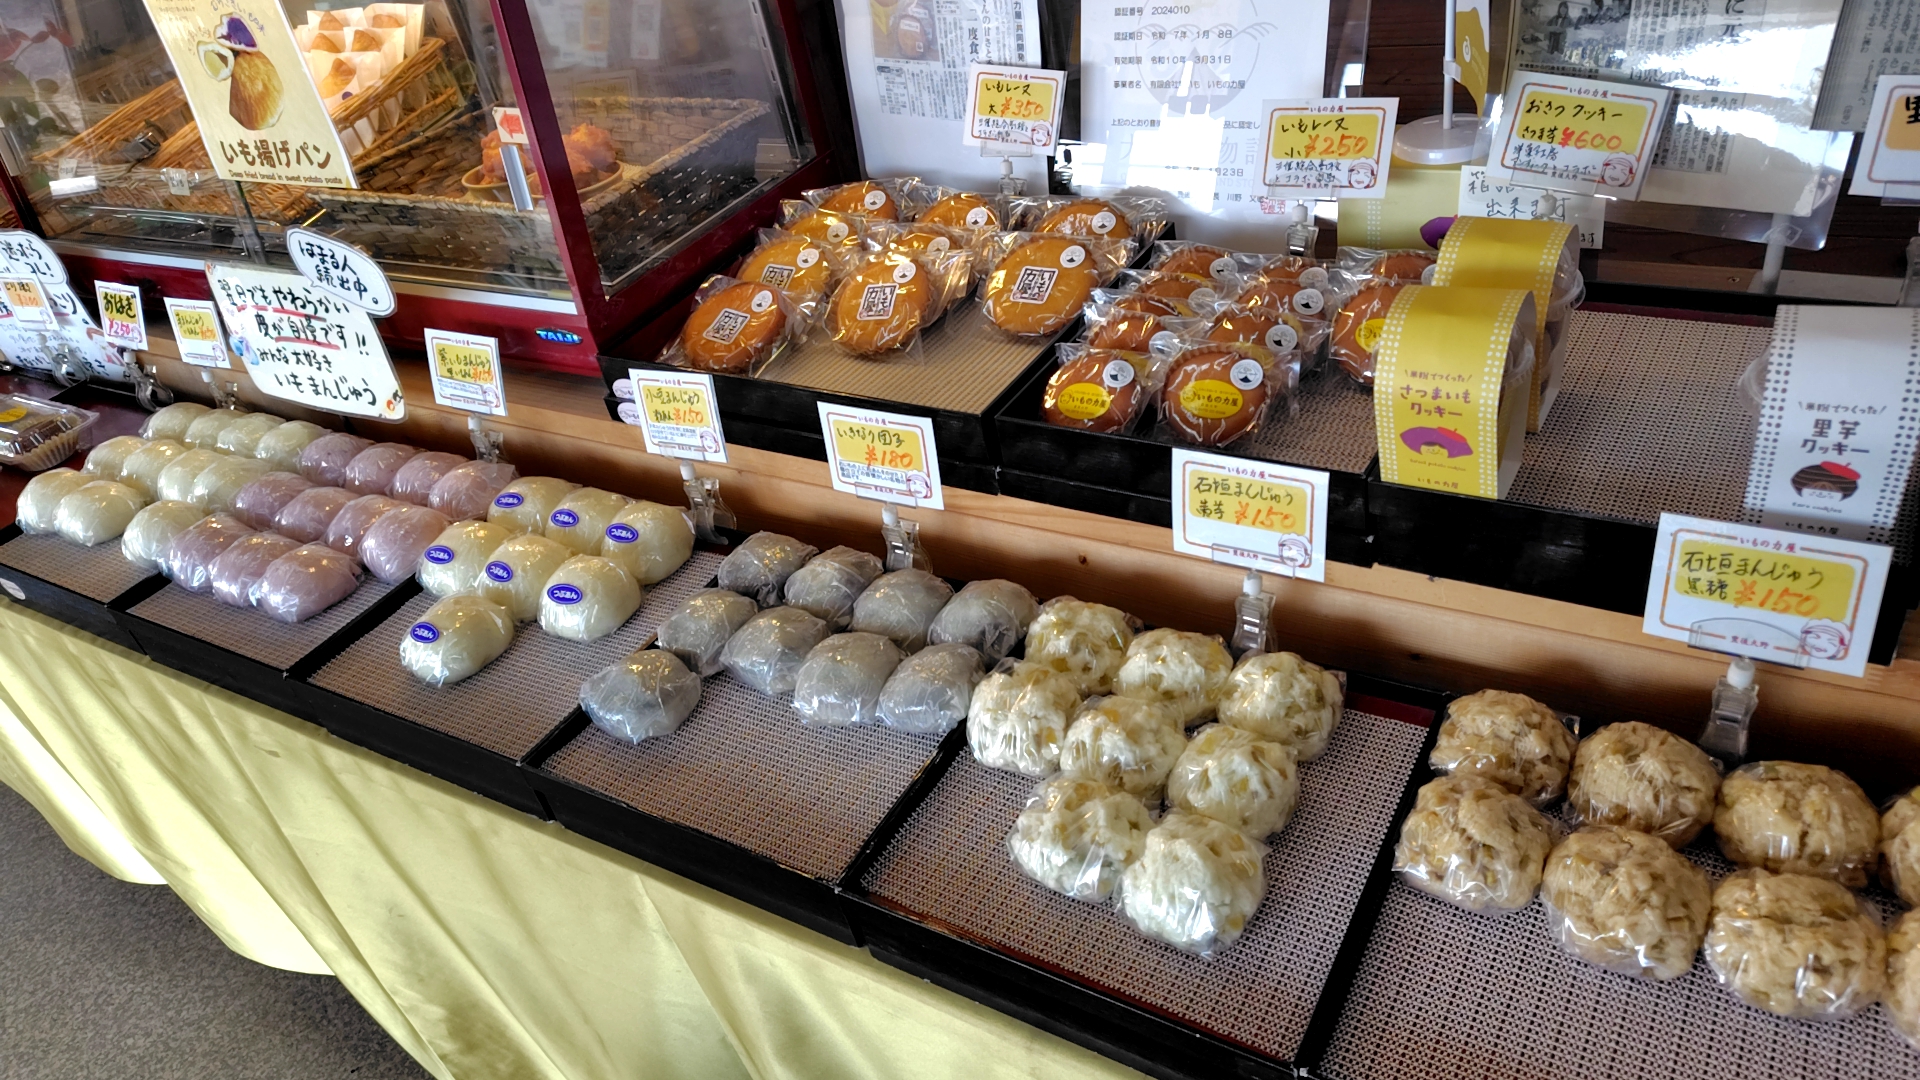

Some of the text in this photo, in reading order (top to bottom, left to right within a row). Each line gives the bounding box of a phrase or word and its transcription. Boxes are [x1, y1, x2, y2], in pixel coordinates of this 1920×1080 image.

[1114, 6, 1190, 17] 認証番号 2024010
[1114, 32, 1143, 41] 認証期日
[1114, 56, 1142, 65] 有効期限
[1194, 55, 1231, 65] 3月31日
[1114, 81, 1142, 89] 事業者名
[1208, 80, 1246, 90] いもの力屋
[1569, 86, 1609, 99] いもの力屋
[989, 97, 1044, 117] 大 ¥350
[1284, 133, 1368, 158] 小 ¥250
[1558, 126, 1622, 150] ¥600
[220, 138, 336, 169] いも揚げパン
[297, 239, 357, 276] はまる人
[103, 291, 137, 319] おはぎ
[108, 318, 131, 336] ¥250
[1197, 393, 1239, 407] いもの力屋
[1400, 384, 1471, 404] さつまいも
[673, 407, 704, 426] ¥150
[1410, 402, 1463, 418] クッキー
[836, 426, 905, 448] いきなり団子
[1812, 418, 1861, 440] 里芋
[864, 443, 914, 468] ¥180
[1800, 438, 1870, 456] クッキー
[1227, 466, 1267, 480] いもの力屋
[1194, 476, 1294, 507] 石垣まんじゅう
[1234, 500, 1297, 530] ¥150
[1785, 521, 1839, 535] いもの力屋
[1739, 537, 1797, 554] いもの力屋
[1682, 551, 1825, 590] 石垣まんじゅう
[1684, 576, 1820, 617] 黒糖 ¥150
[1730, 635, 1770, 650] 豊後大野
